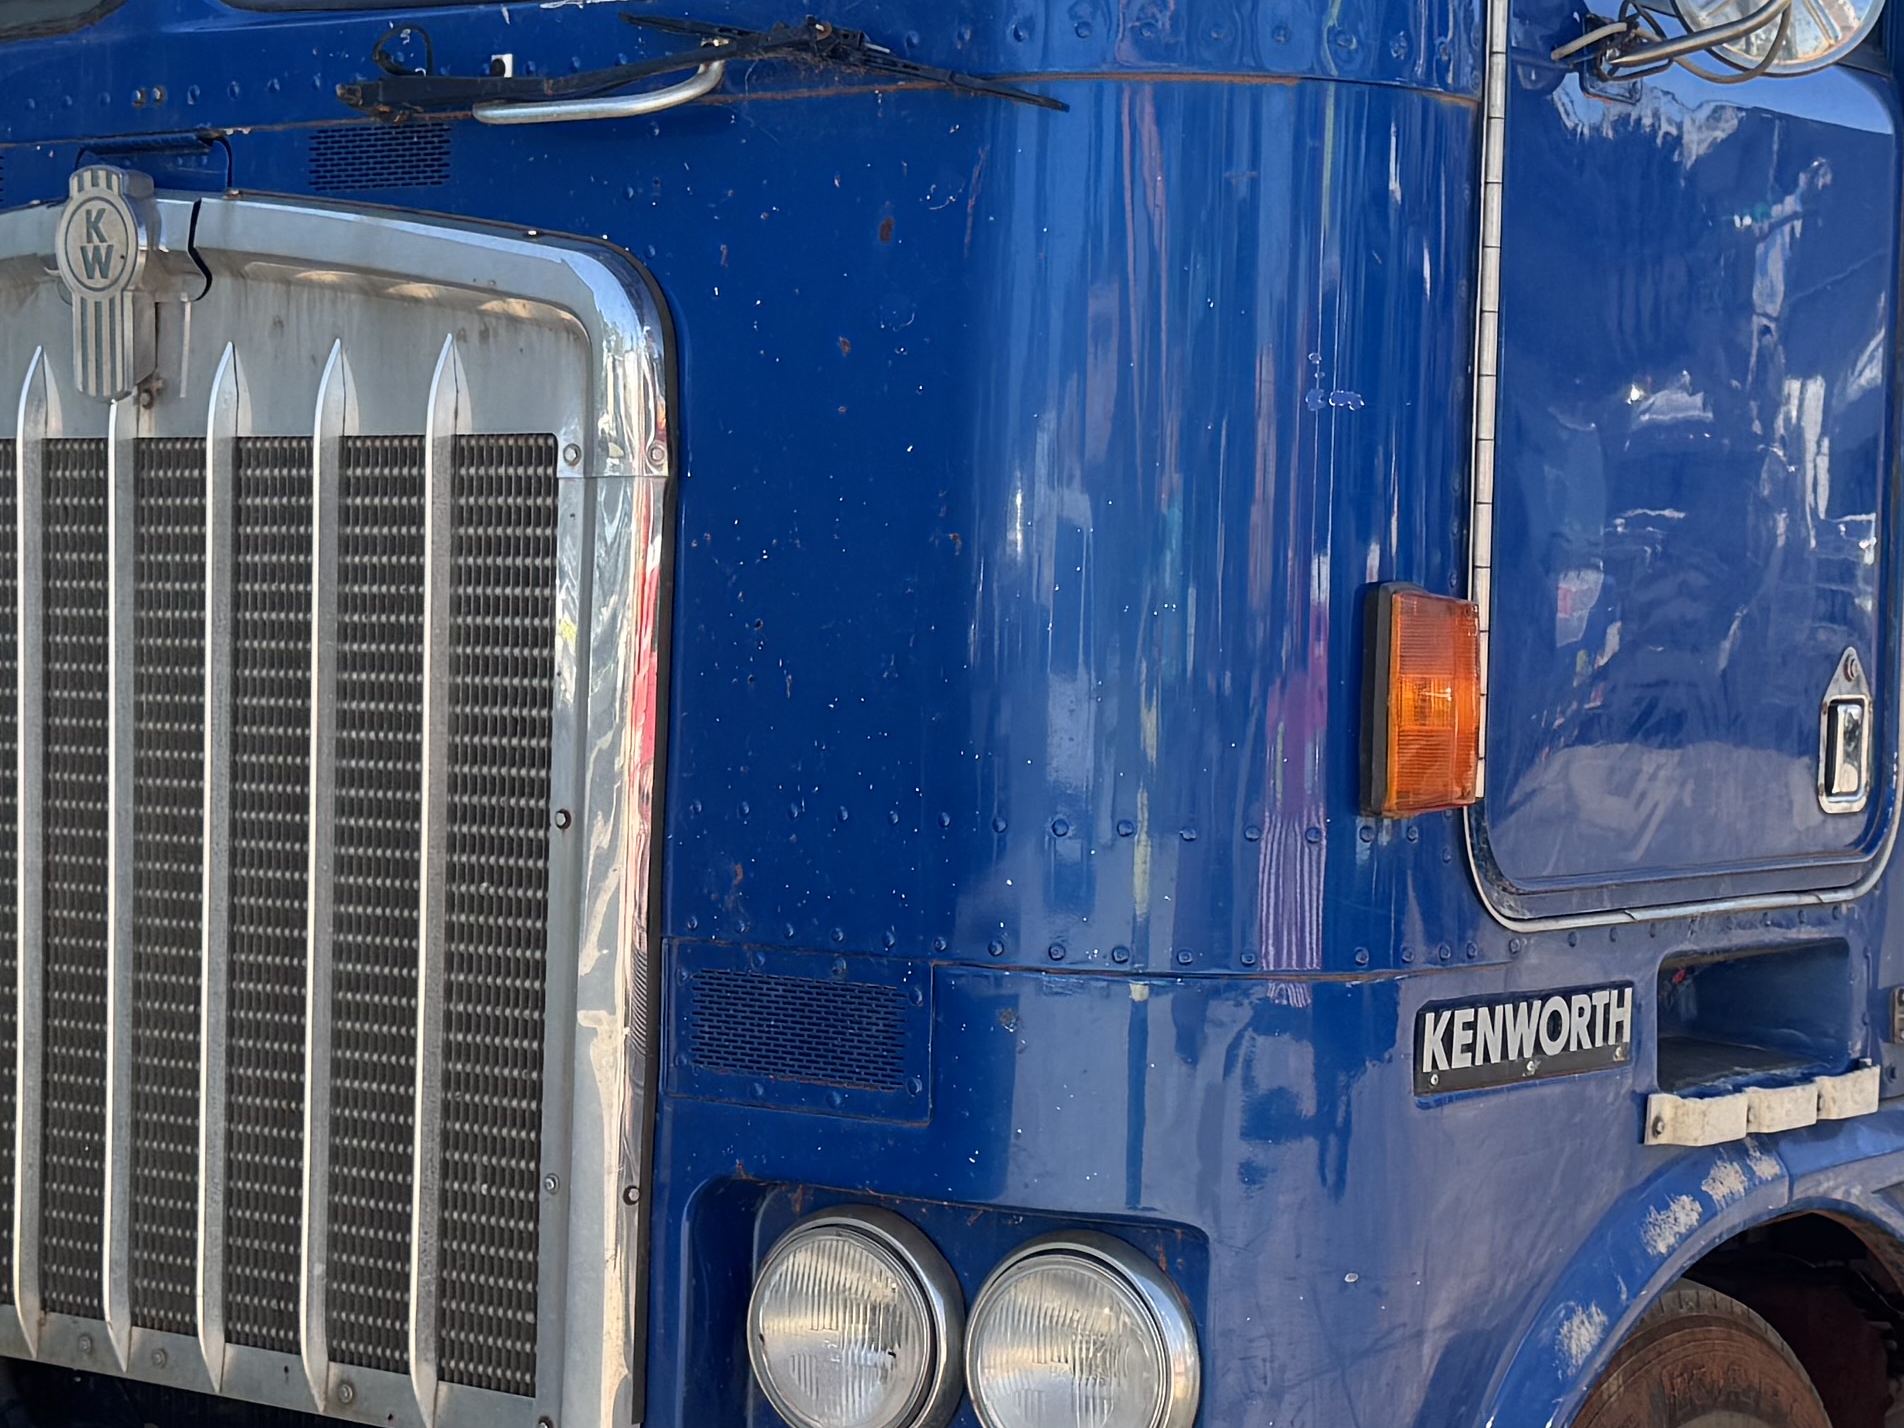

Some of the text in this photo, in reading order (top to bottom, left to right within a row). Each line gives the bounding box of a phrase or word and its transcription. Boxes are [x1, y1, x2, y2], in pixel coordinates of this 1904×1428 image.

[85, 207, 109, 244] K
[80, 244, 114, 280] W
[1422, 987, 1633, 1073] KENWORTH
